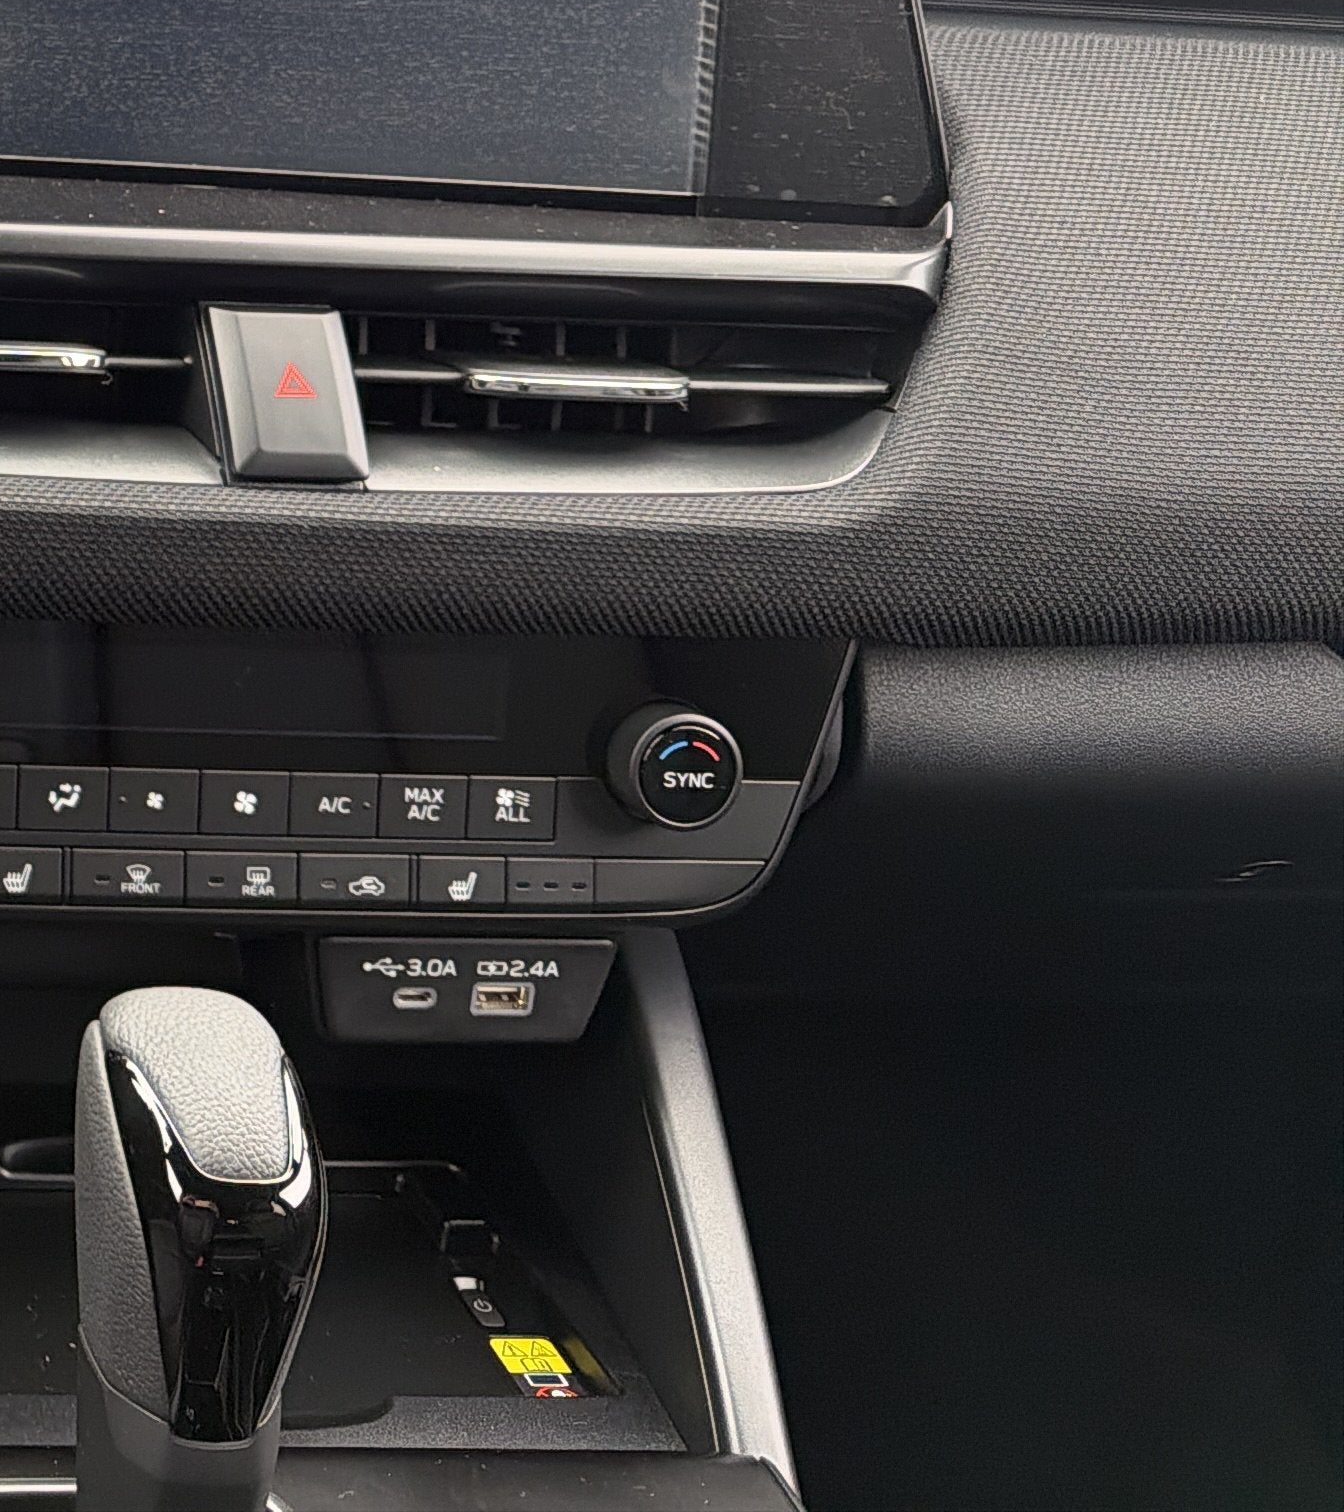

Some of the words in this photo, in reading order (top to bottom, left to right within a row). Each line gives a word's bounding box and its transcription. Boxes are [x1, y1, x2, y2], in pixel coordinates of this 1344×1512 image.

[662, 771, 714, 789] SYNC
[318, 796, 352, 814] A/C
[405, 788, 444, 804] MAX
[407, 804, 441, 822] A/C
[495, 806, 530, 823] ALL
[120, 882, 161, 894] FRONT
[241, 884, 275, 897] REAR
[406, 959, 457, 977] 3.0A
[509, 960, 560, 978] 2.4A
